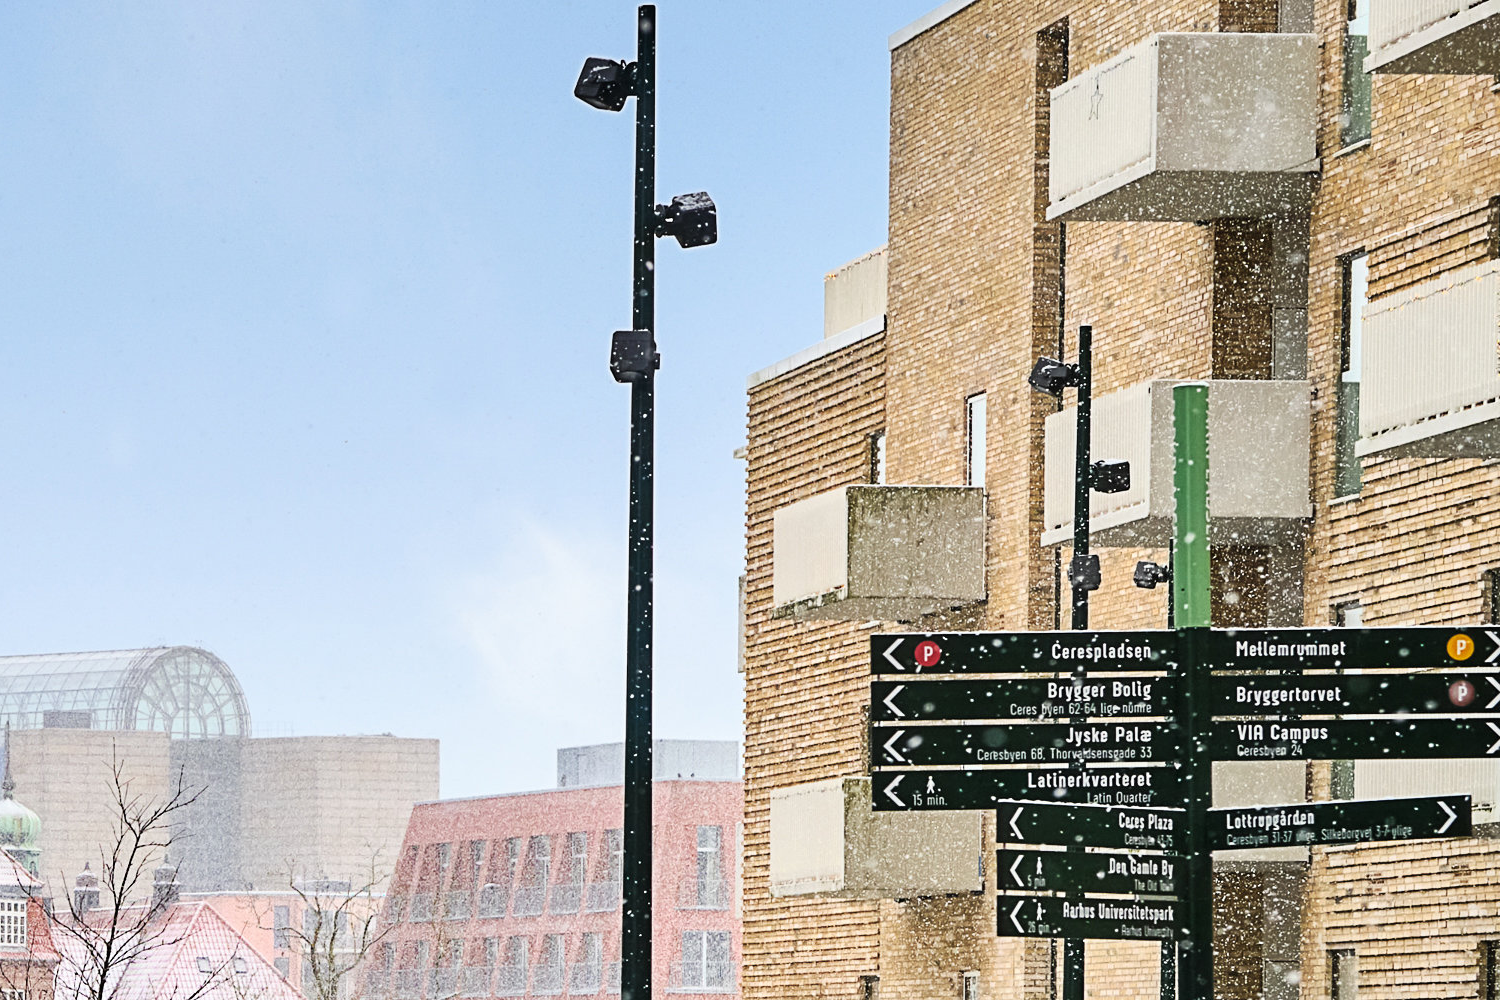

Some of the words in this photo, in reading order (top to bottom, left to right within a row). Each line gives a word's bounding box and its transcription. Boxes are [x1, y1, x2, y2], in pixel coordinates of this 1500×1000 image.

[924, 646, 933, 662] P
[1051, 643, 1151, 663] Cerespladsen
[1236, 641, 1347, 657] Mellemrummet
[1456, 640, 1467, 656] P
[1047, 682, 1106, 702] Brygger
[1112, 681, 1152, 701] Bolig
[1236, 686, 1341, 706] Bryggertorvet
[1457, 686, 1468, 702] P
[1010, 704, 1037, 716] Ceres
[1041, 704, 1064, 717] byen
[1068, 702, 1097, 715] 62-64
[1100, 702, 1119, 716] lige
[1065, 727, 1109, 746] Jyske
[1115, 726, 1152, 742] Palæ
[1237, 724, 1263, 741] VIA
[1270, 724, 1329, 744] Campus
[977, 747, 1027, 762] Ceresbyen
[1050, 746, 1136, 762] Thorvaldsensgade
[1140, 746, 1152, 758] 33
[1237, 744, 1287, 758] Ceresbyen
[1291, 744, 1303, 756] 24
[1028, 772, 1152, 788] Latinerkvarteret
[912, 794, 923, 806] 15
[927, 794, 948, 806] min.
[1087, 792, 1111, 804] Latin
[1116, 791, 1151, 804] Quarter
[1118, 812, 1145, 829] Ceres
[1148, 813, 1173, 830] Plaza
[1226, 810, 1315, 831] Lottrupgården
[1226, 832, 1269, 847] Ceresbyen
[1272, 830, 1293, 843] 31-37
[1108, 858, 1127, 874] Den
[1130, 858, 1158, 875] Gamle
[1162, 860, 1174, 879] By
[1027, 874, 1032, 887] 5
[1134, 878, 1145, 891] The
[1063, 902, 1095, 919] Aarhus
[1098, 903, 1174, 924] Universitetspark
[1121, 924, 1142, 937] Aarhus
